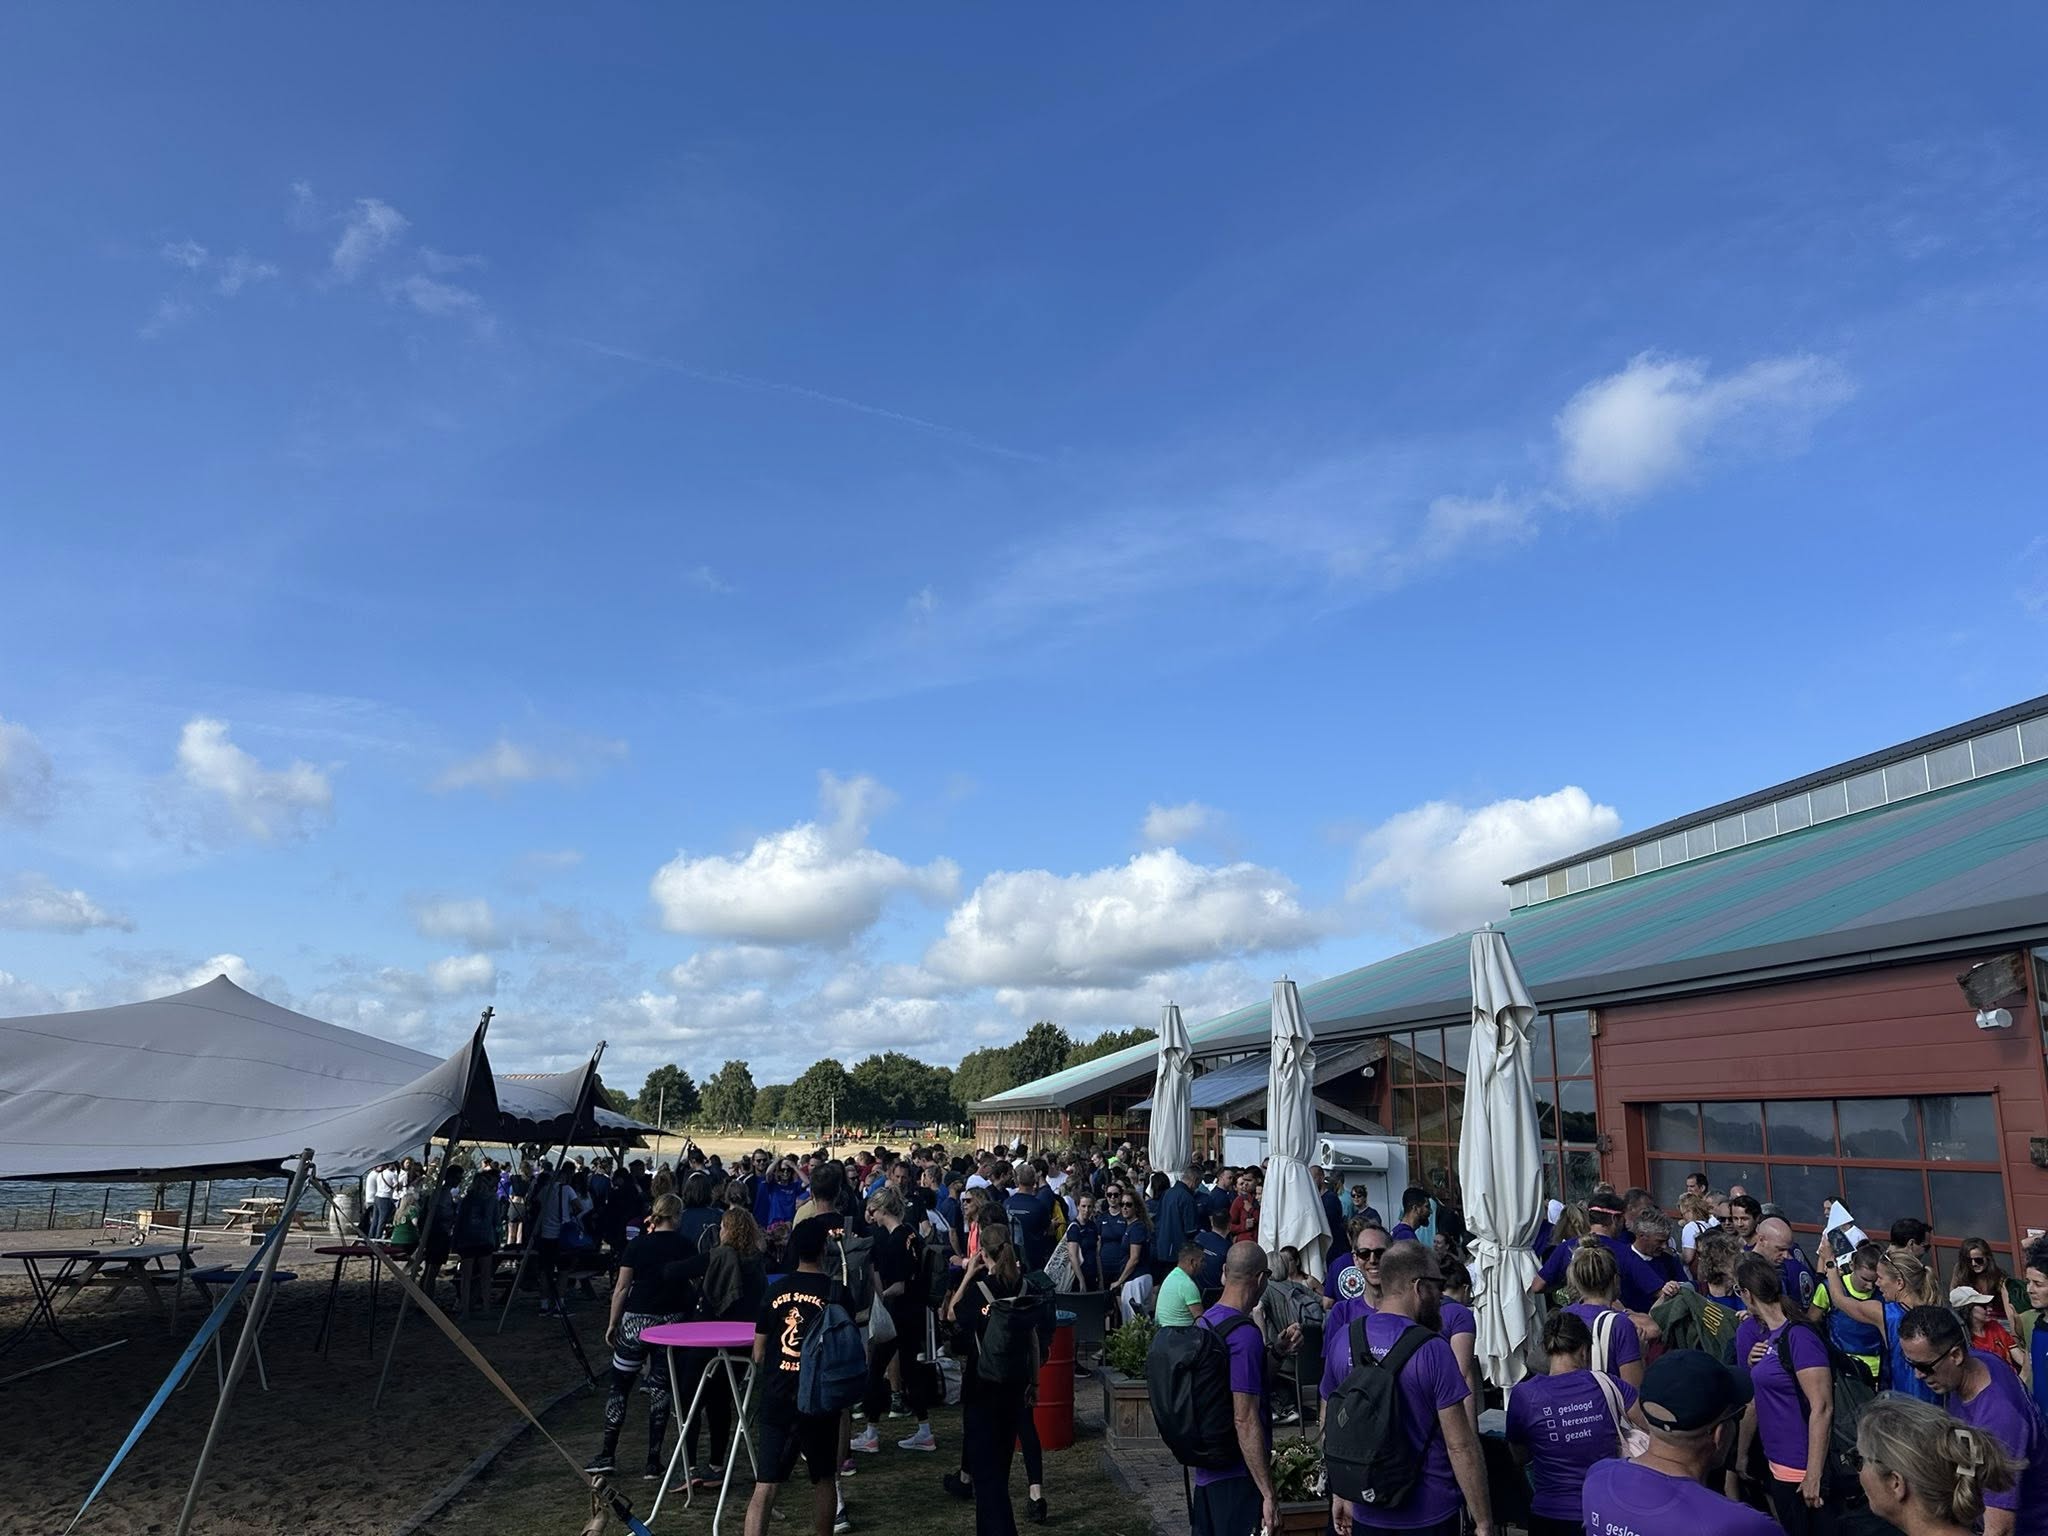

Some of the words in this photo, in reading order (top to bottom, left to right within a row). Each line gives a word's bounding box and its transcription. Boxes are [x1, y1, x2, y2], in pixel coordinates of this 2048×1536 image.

[779, 1360, 800, 1371] 2025
[1558, 1400, 1593, 1416] geslaagd
[1562, 1414, 1603, 1427] herexamen
[1565, 1429, 1592, 1442] gezakt
